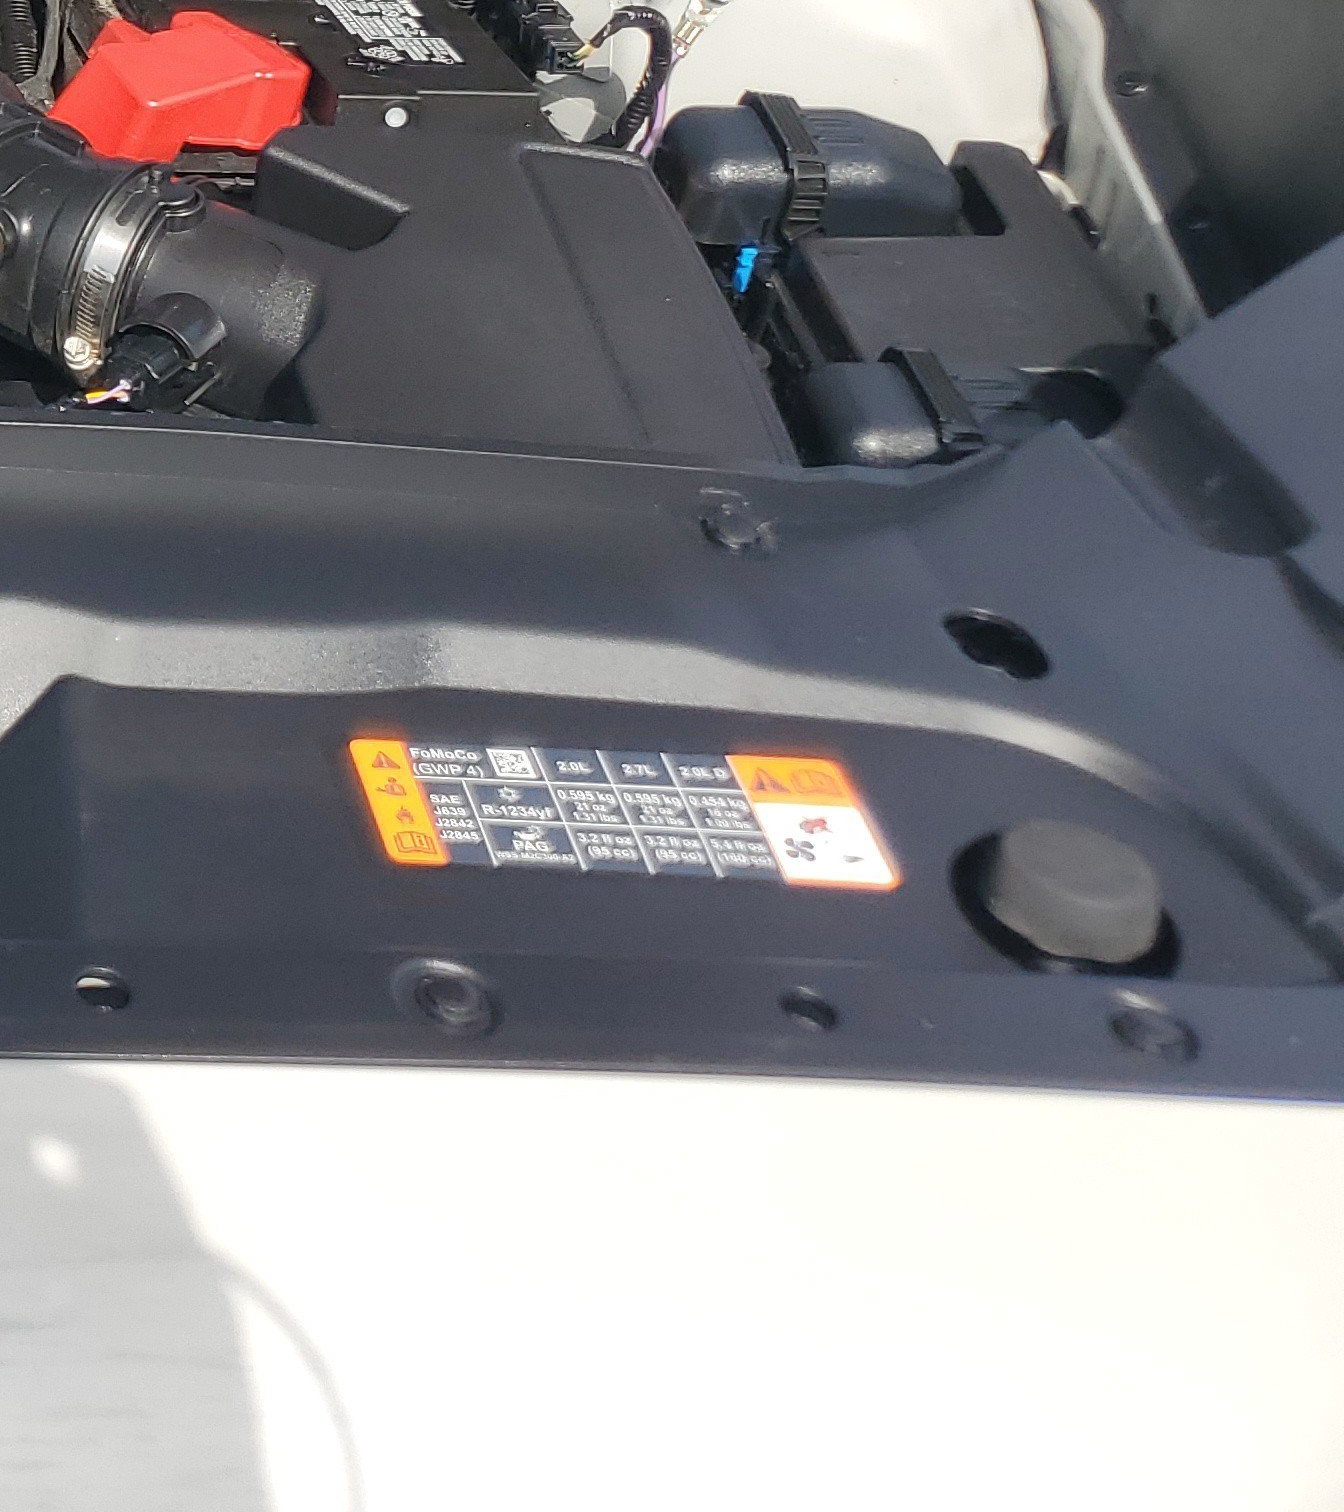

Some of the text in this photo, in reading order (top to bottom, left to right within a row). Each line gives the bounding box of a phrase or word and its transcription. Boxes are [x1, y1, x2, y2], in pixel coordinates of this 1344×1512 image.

[409, 747, 478, 760] FoMoCo
[413, 763, 484, 778] (GWP 4)
[556, 760, 590, 771] 2.0L
[621, 763, 655, 775] 2.7L
[430, 793, 461, 804] SAE
[557, 789, 615, 805] 0.595 kg
[623, 792, 682, 807] 0.595 kg
[573, 801, 608, 812] 21 oz
[727, 796, 749, 812] kg
[481, 804, 553, 821] R-1234yf
[658, 807, 674, 815] oz
[439, 830, 479, 840] J2845
[576, 833, 599, 843] 3.2
[615, 836, 632, 845] oz
[512, 839, 550, 852] PAG
[587, 845, 637, 860] (95 cc)
